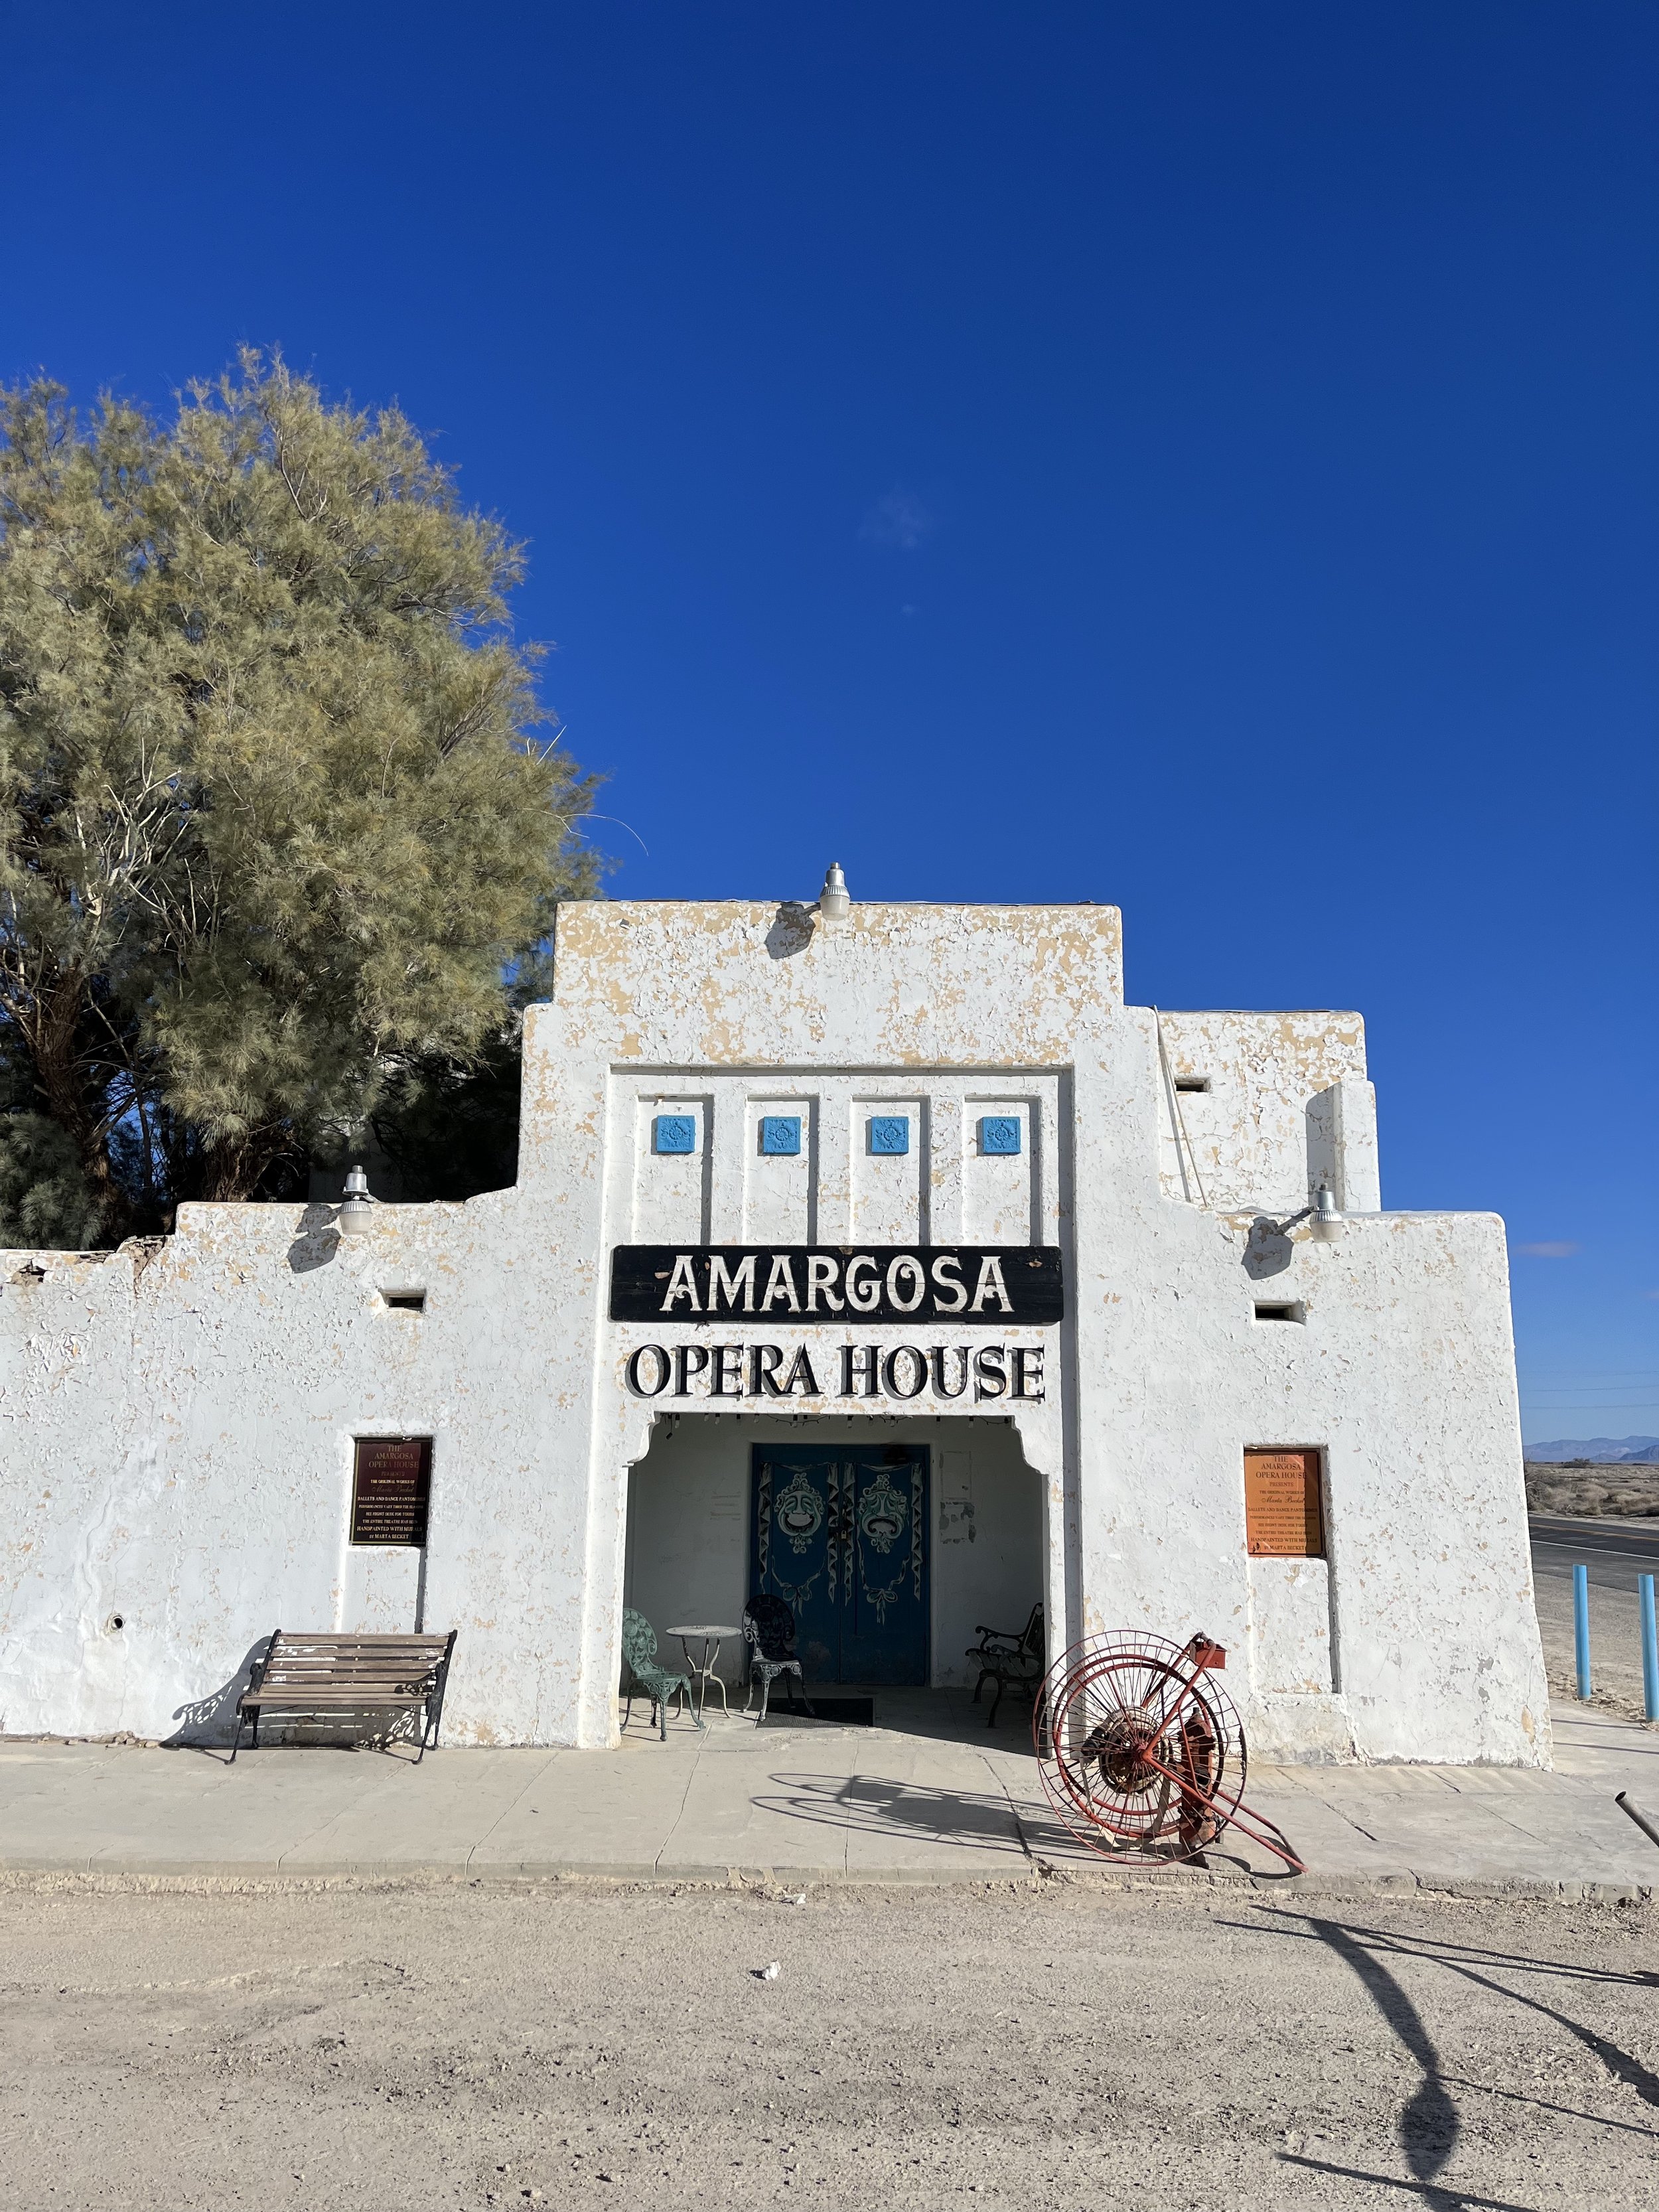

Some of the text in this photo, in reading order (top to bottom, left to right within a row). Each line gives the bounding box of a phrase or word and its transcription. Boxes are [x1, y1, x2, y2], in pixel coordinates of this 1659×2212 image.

[660, 1254, 1015, 1313] AMARGOSA
[629, 1342, 1046, 1402] OPERA HOUSE
